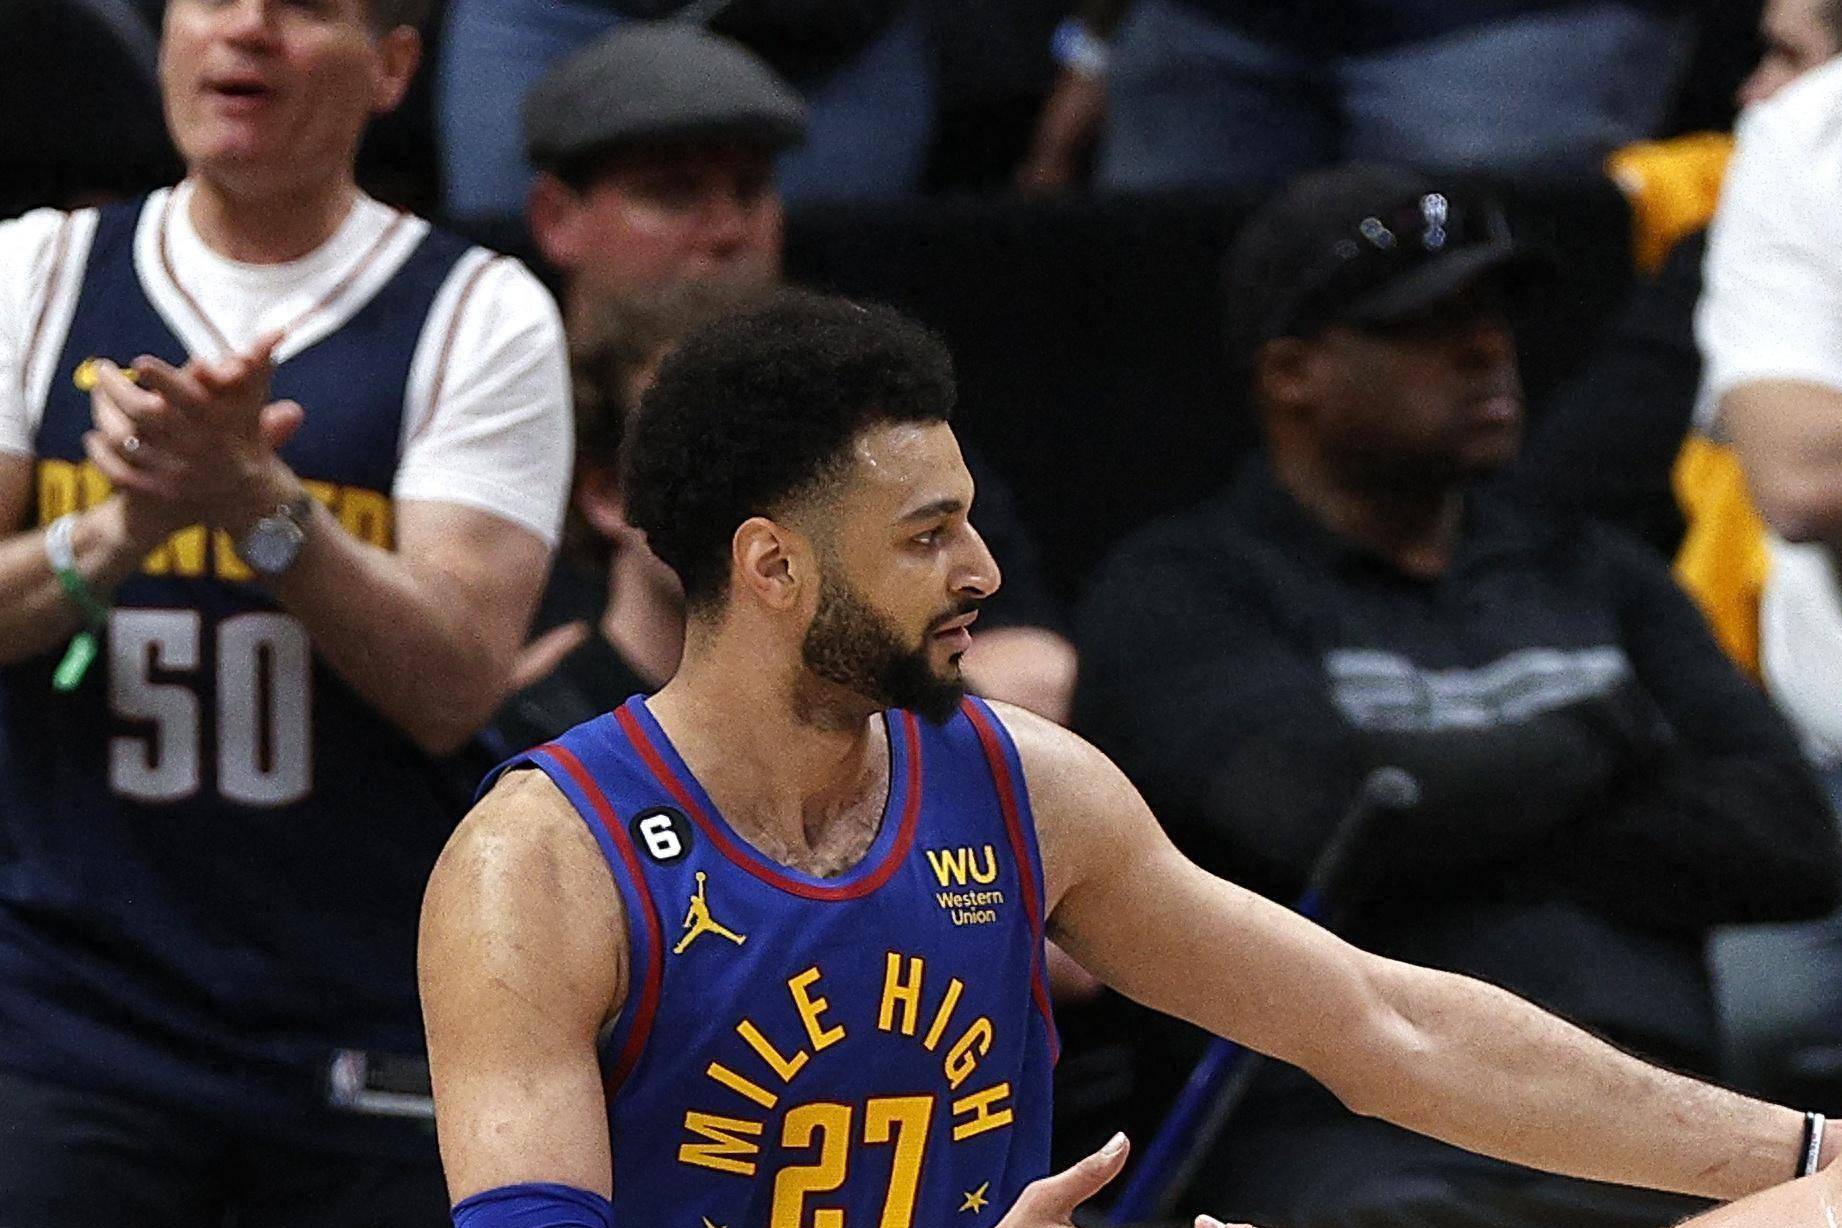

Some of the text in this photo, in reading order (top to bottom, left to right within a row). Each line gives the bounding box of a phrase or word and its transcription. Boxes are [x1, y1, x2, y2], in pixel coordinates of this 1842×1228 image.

[107, 607, 313, 807] 50
[639, 813, 682, 860] 6
[926, 845, 998, 887] WU
[936, 889, 1004, 909] Western
[951, 905, 997, 926] Union
[677, 951, 1015, 1176] MILE HIGH
